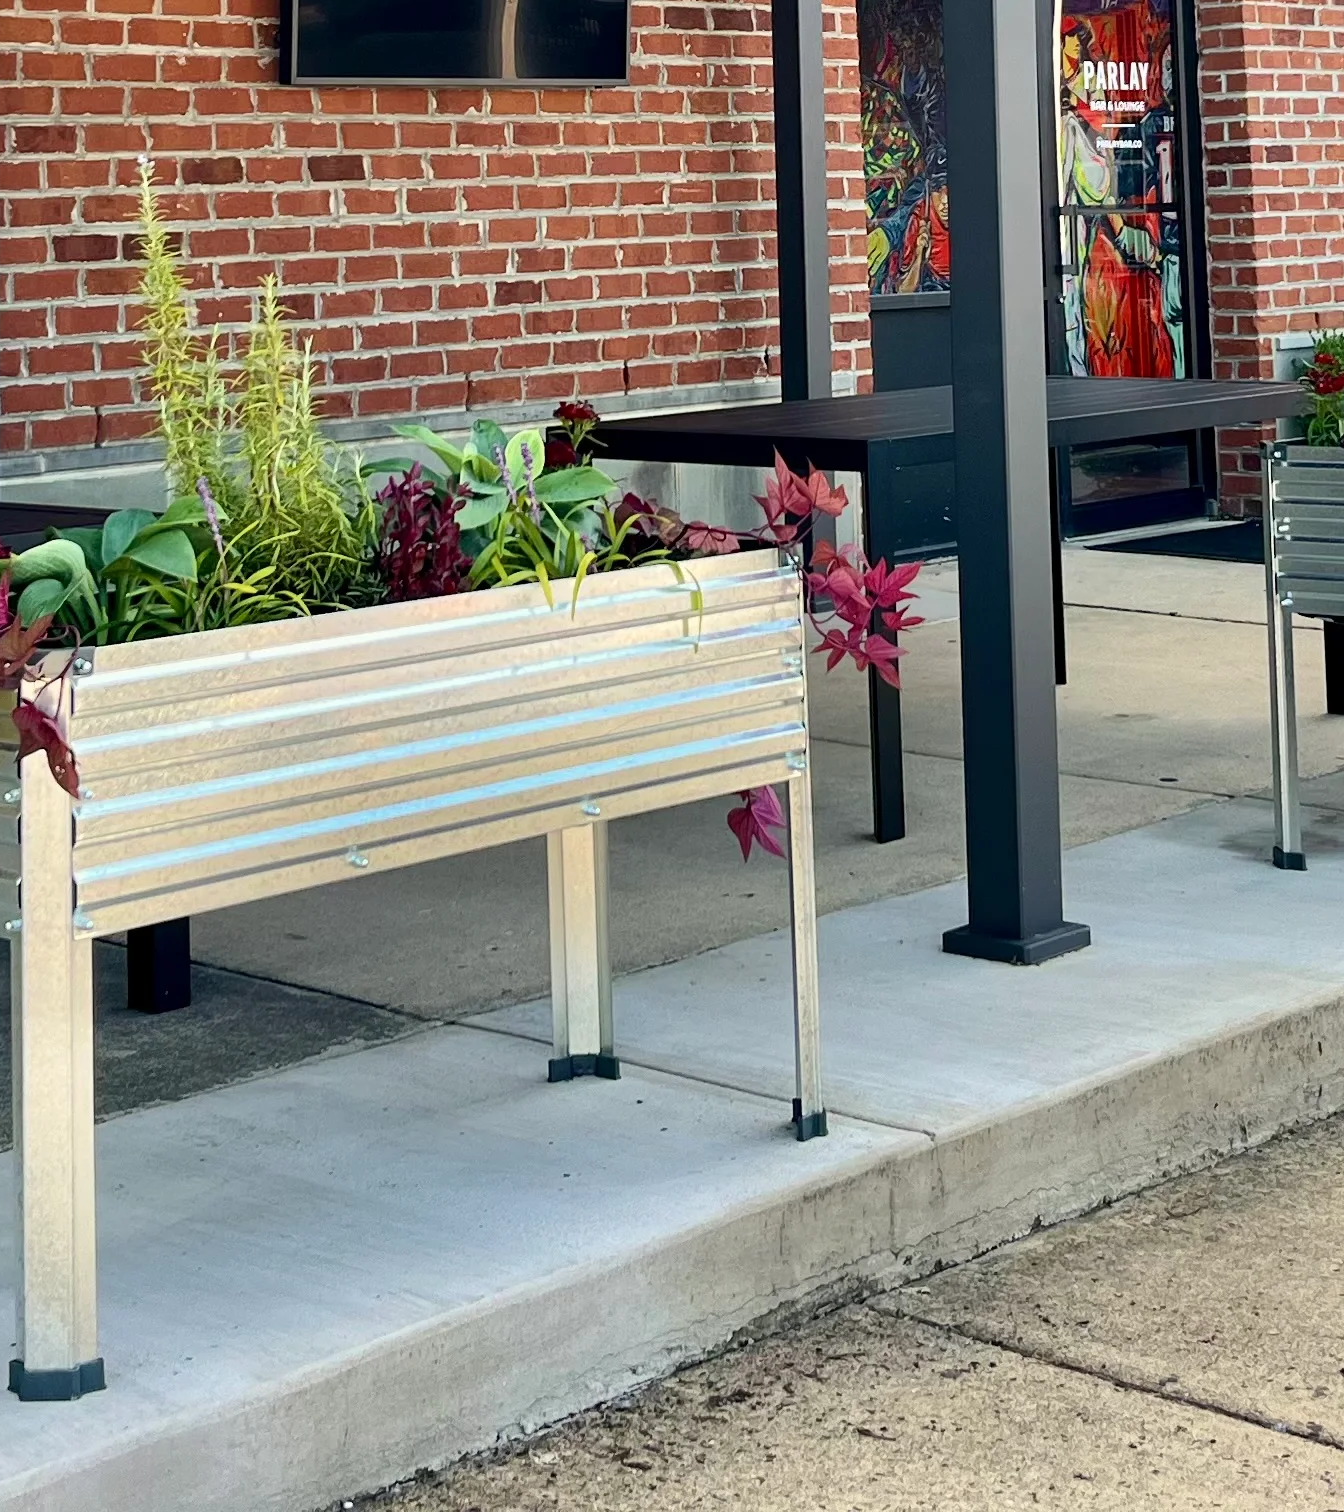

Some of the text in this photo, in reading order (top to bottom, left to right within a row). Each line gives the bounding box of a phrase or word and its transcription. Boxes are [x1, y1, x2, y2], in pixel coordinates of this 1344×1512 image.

[1083, 60, 1150, 91] PARLAY
[1089, 100, 1107, 112] BAR
[1114, 100, 1146, 112] LOUNGE
